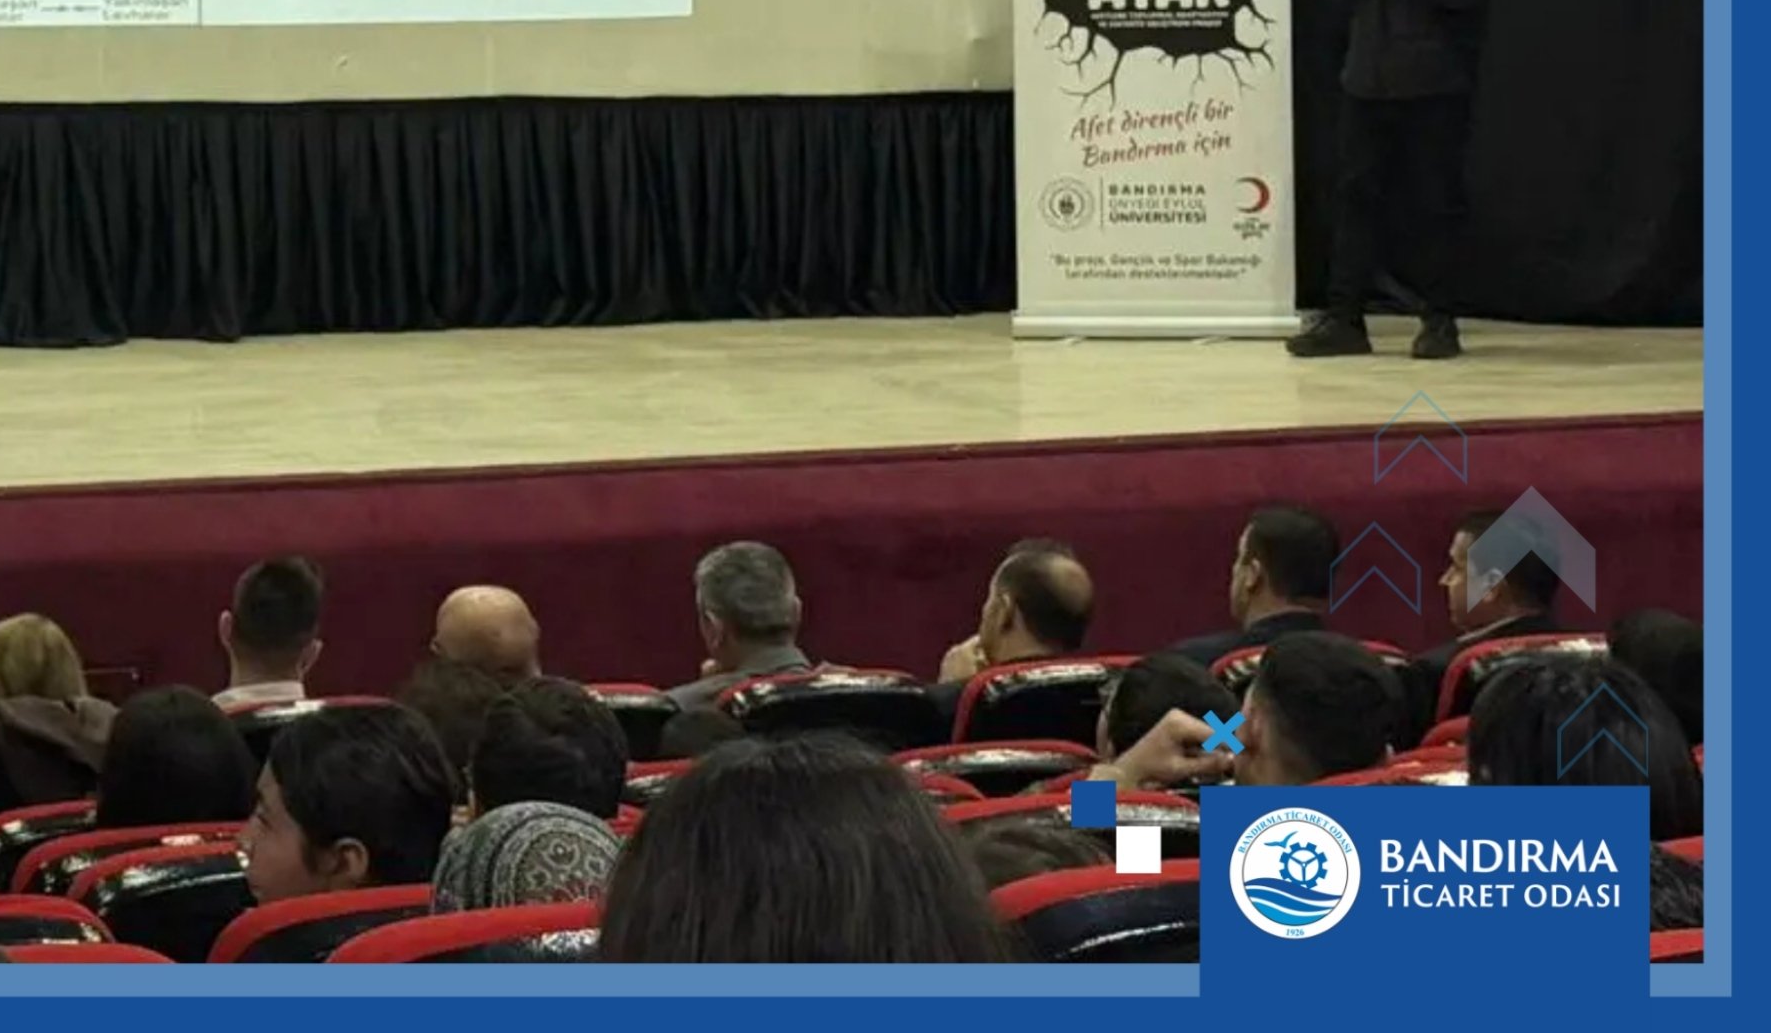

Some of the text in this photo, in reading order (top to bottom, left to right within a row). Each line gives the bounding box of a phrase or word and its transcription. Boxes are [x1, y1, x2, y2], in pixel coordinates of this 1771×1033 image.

[1204, 97, 1234, 121] bir
[1082, 130, 1232, 167] Bandırma için
[1108, 184, 1207, 196] BANDIRMA
